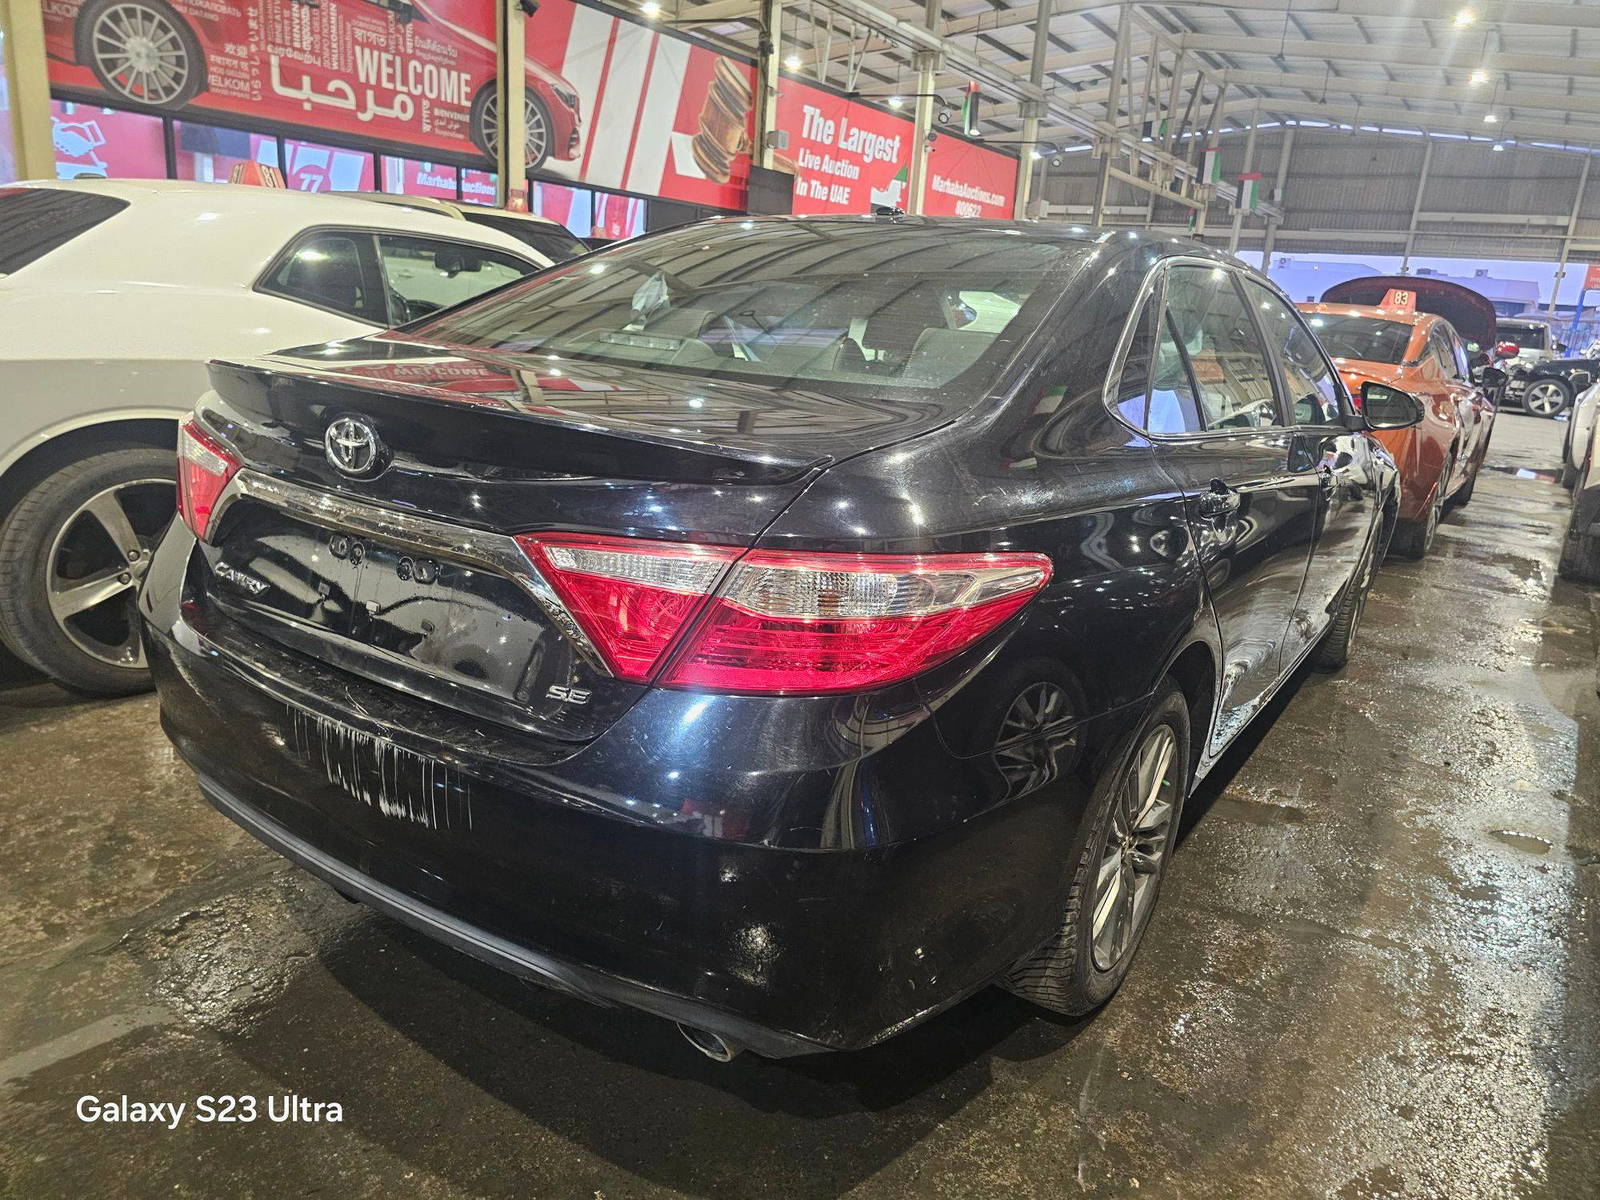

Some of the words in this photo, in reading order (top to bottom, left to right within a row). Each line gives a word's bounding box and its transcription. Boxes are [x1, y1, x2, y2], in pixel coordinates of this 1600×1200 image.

[330, 3, 339, 70] WILLKOMMEN
[269, 54, 415, 122] مرحبا
[354, 45, 472, 107] WELCOME
[802, 105, 835, 145] The
[838, 117, 901, 164] Largest
[798, 148, 821, 171] Live
[821, 154, 860, 180] Auction
[301, 173, 323, 194] 77
[796, 178, 808, 197] In
[810, 179, 829, 201] The
[829, 184, 851, 205] UAE
[932, 174, 1006, 208] MarhabaAuctions.com
[1394, 291, 1409, 306] 83
[214, 561, 271, 595] CAMRY
[545, 685, 592, 705] SE
